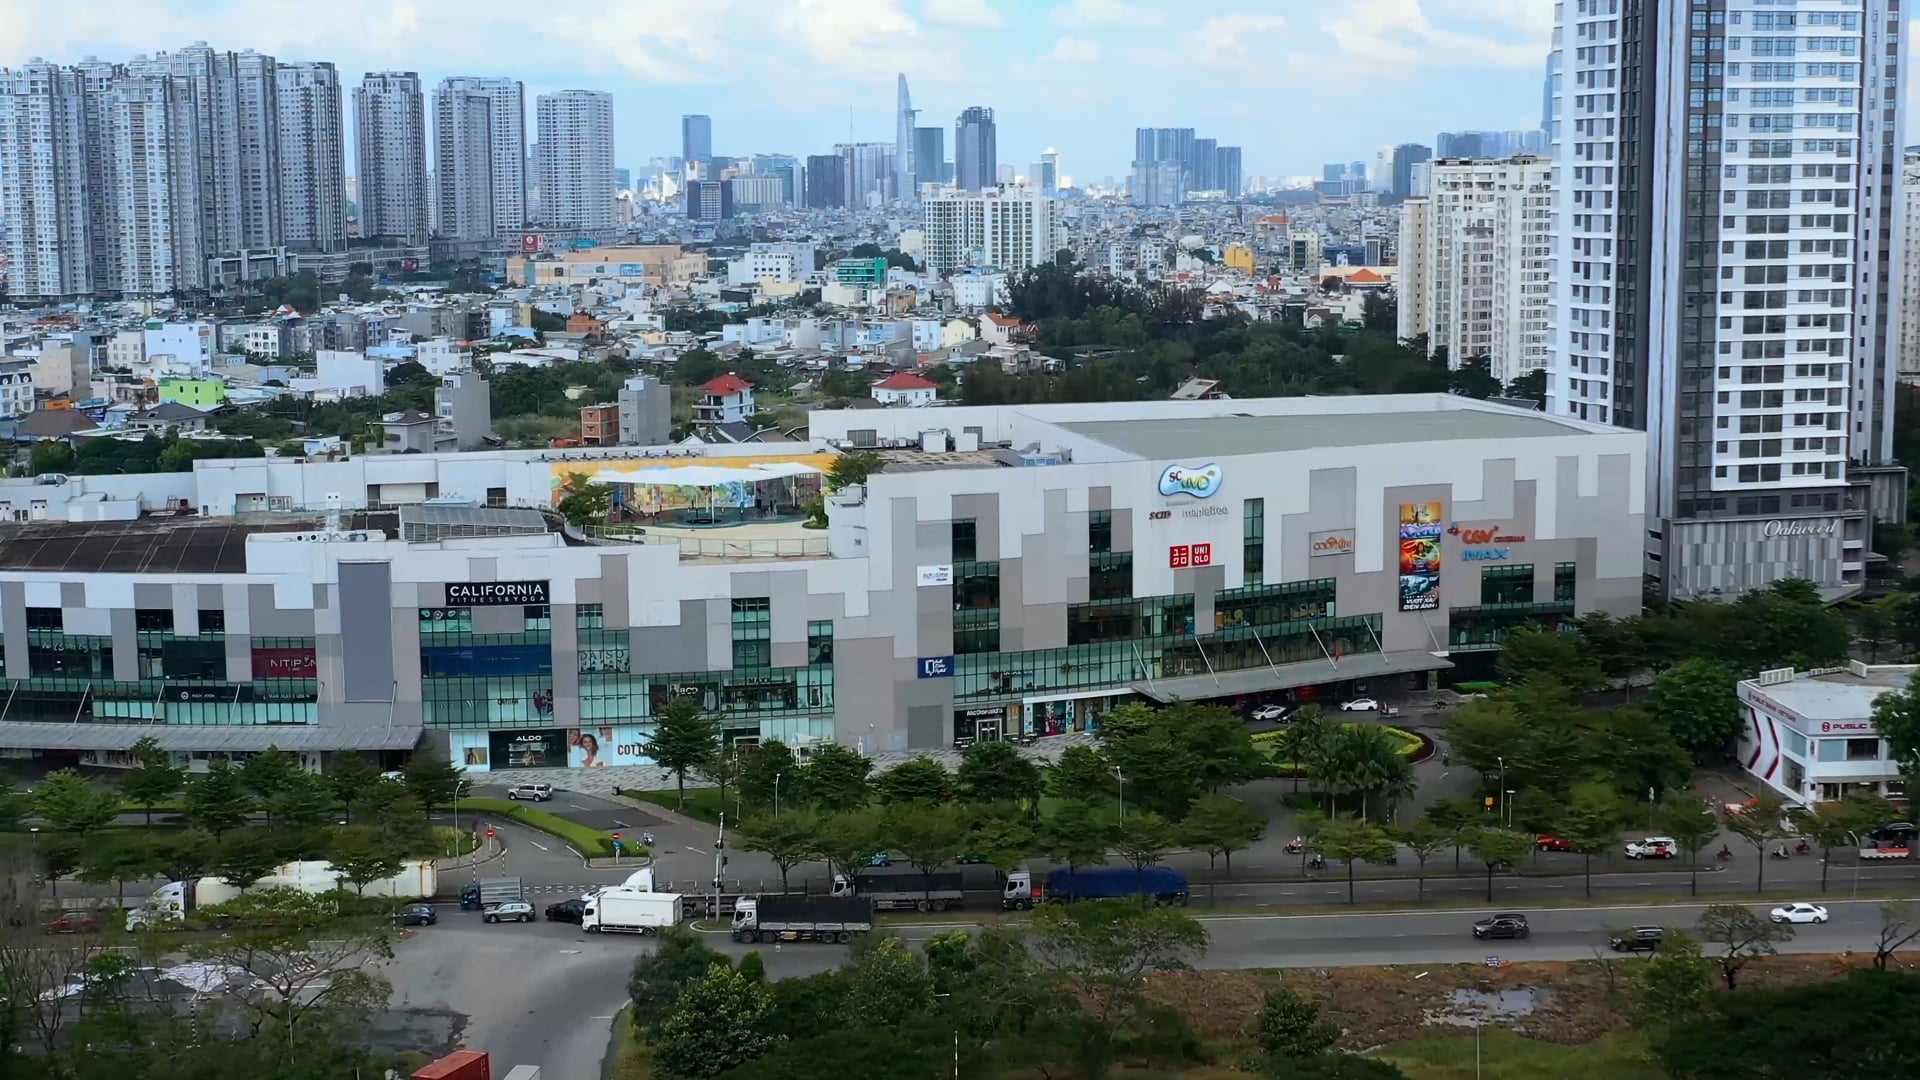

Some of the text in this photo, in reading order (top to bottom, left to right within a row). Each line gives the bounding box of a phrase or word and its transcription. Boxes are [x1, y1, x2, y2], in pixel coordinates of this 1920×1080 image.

[1764, 519, 1838, 537] Oakwood
[449, 584, 543, 597] CALIFORNIA
[580, 650, 625, 660] DAISO
[515, 734, 542, 742] ALDO
